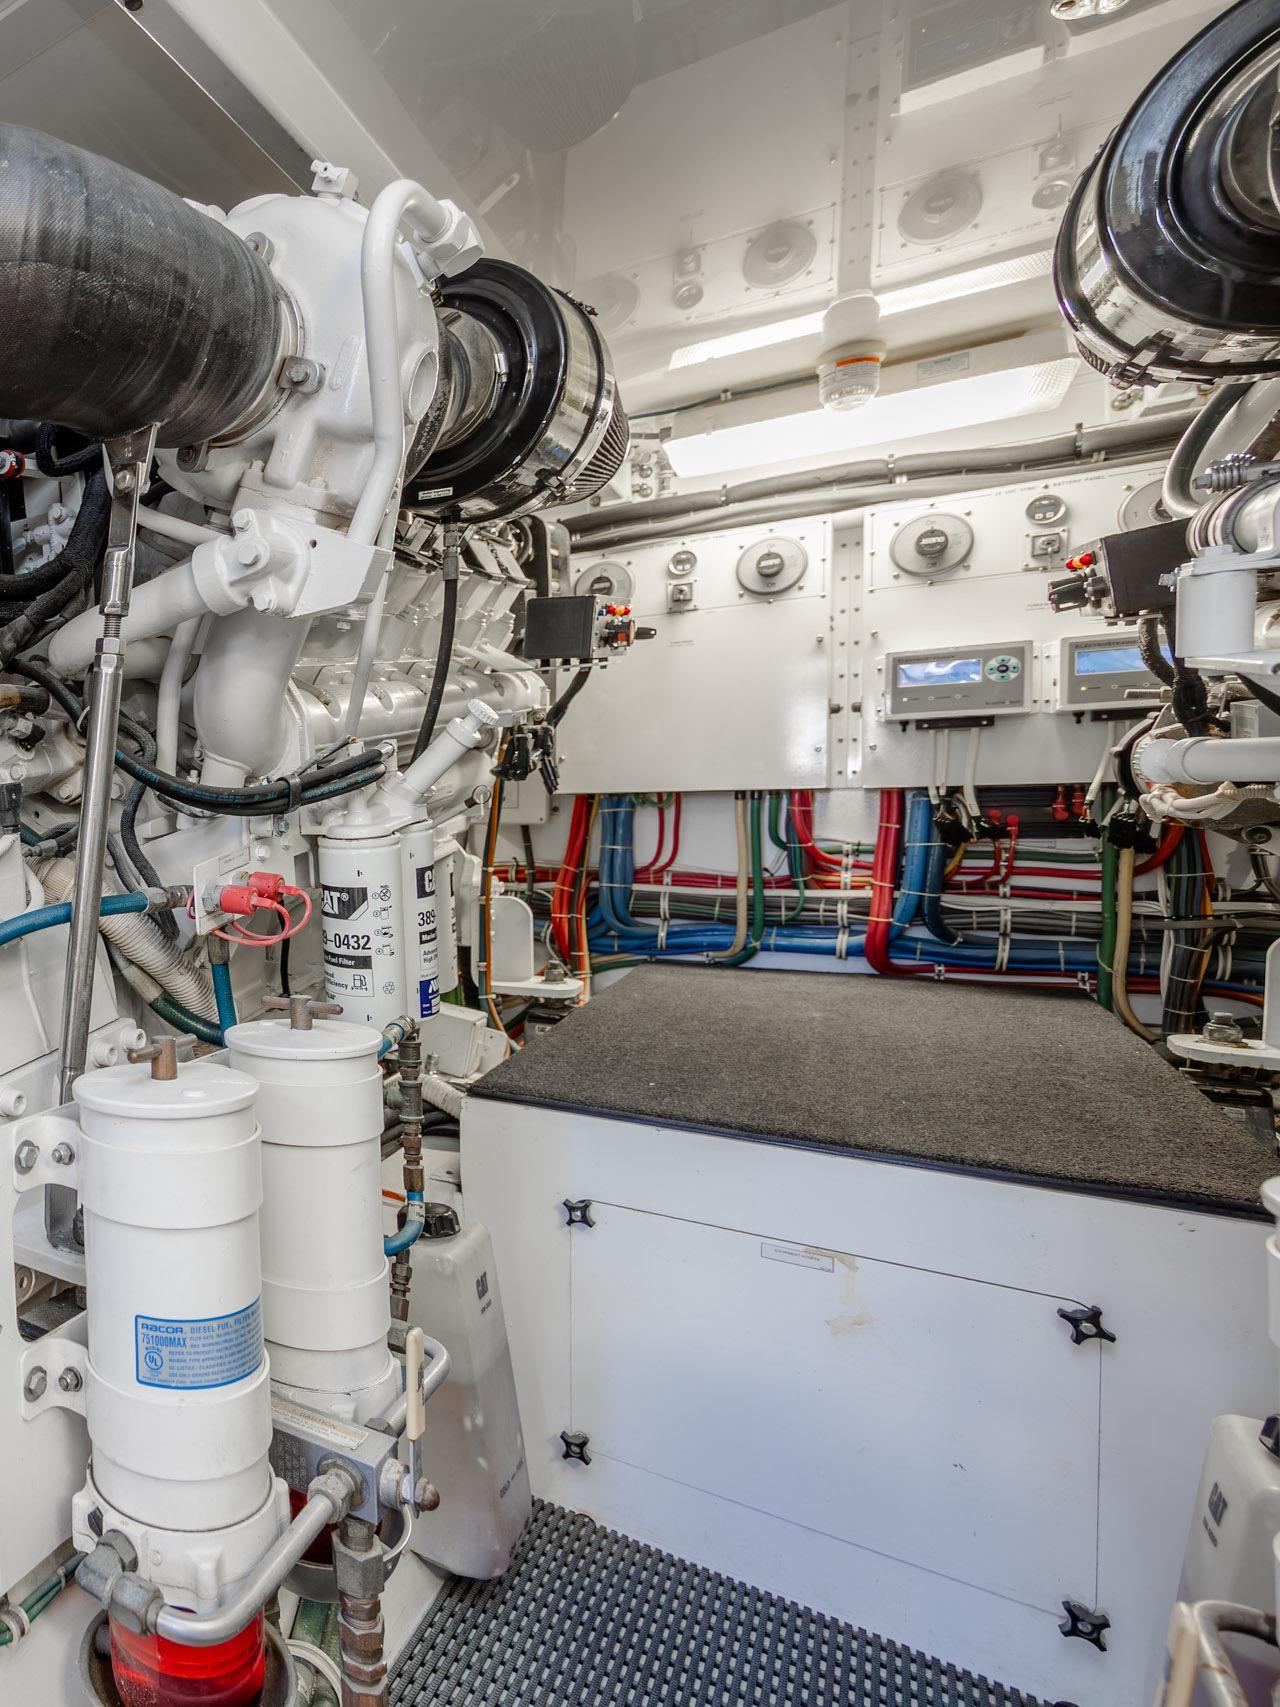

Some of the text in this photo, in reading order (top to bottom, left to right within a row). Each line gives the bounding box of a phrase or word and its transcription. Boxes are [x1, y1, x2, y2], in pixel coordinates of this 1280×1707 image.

[321, 889, 340, 915] AT
[475, 1271, 489, 1300] CAT
[190, 1325, 215, 1334] DIESEL
[217, 1321, 233, 1331] FUEL
[141, 1332, 187, 1349] 751000MAX
